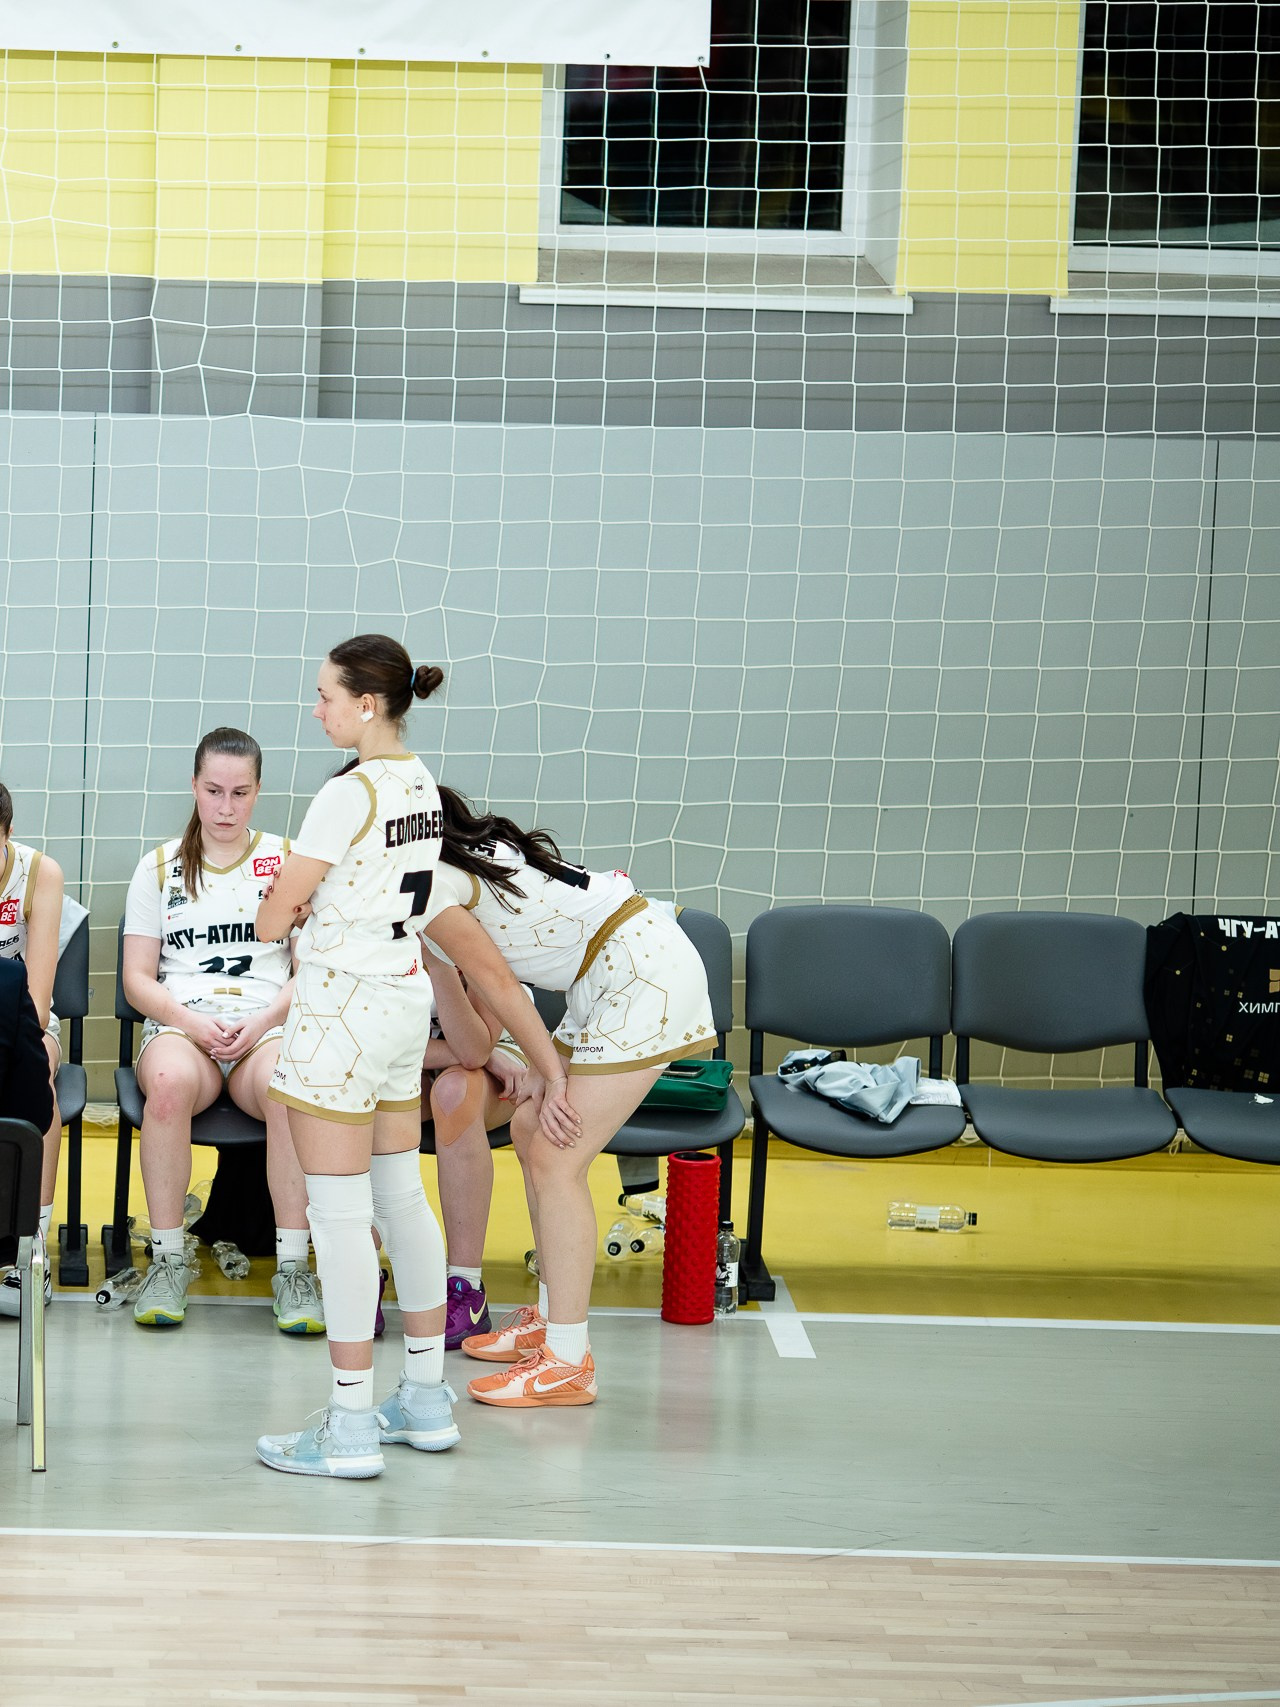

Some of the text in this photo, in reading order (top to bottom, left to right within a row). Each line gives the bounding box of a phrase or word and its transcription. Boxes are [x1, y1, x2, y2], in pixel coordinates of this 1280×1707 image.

[255, 856, 280, 867] FON
[1, 902, 19, 913] FON
[0, 912, 17, 922] BET
[166, 923, 284, 950] ЧГУ-АТЛА
